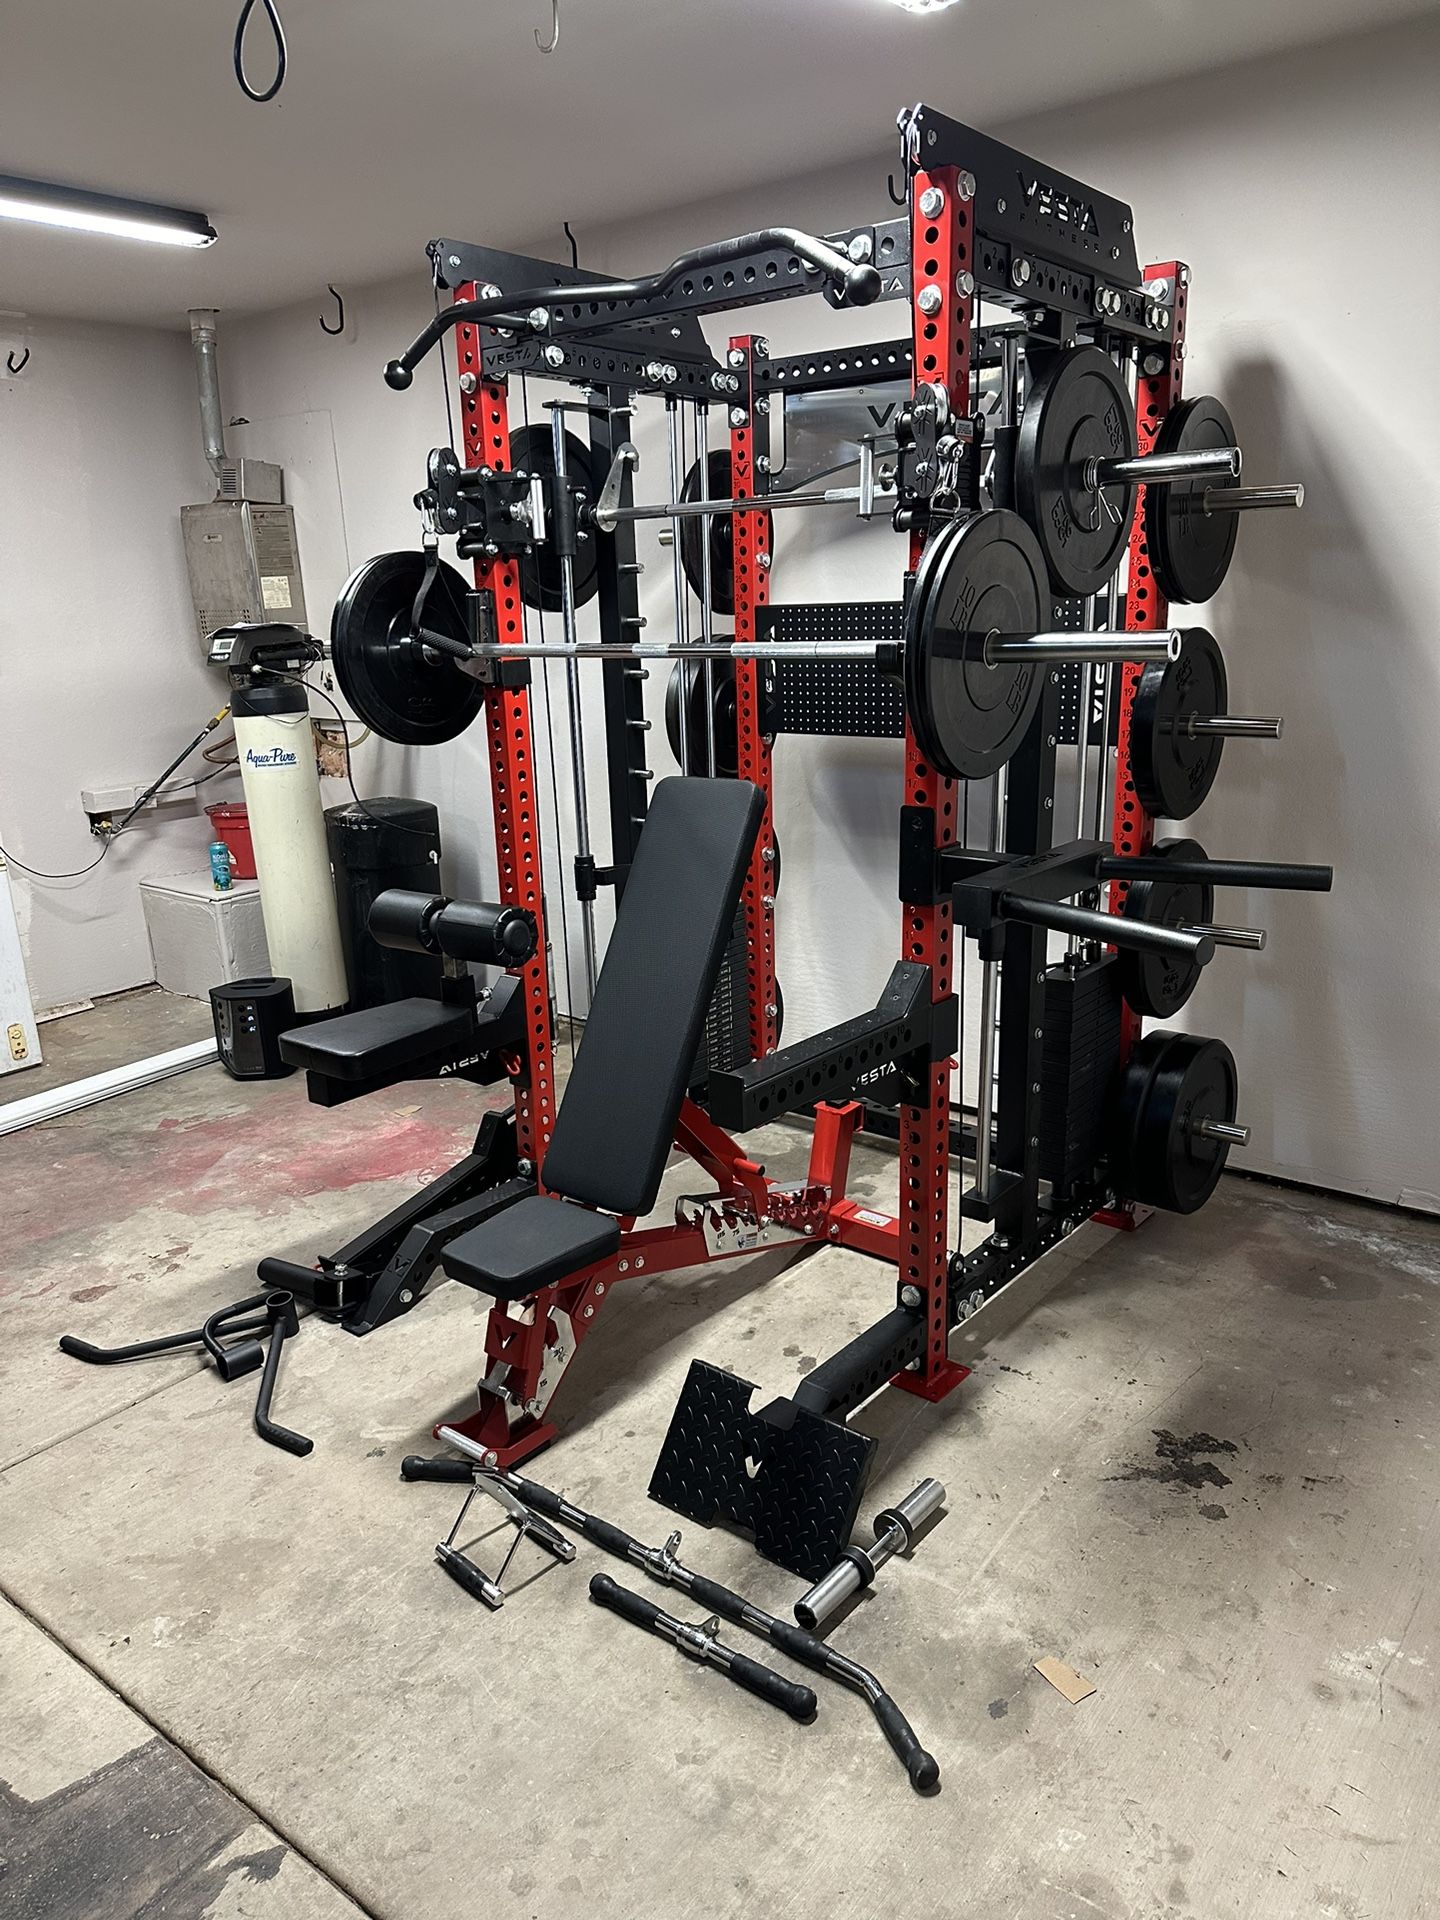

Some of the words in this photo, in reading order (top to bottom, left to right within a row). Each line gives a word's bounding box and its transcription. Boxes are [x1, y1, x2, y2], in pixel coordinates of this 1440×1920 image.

[1016, 169, 1099, 236] VESTA
[992, 247, 998, 260] 2
[833, 277, 904, 301] VTA
[486, 349, 532, 365] VESTA
[1138, 442, 1149, 451] 30
[1133, 511, 1144, 521] 27
[1132, 533, 1145, 544] 26
[1130, 556, 1142, 566] 25
[1129, 601, 1140, 611] 23
[1125, 666, 1136, 676] 20
[1124, 687, 1134, 697] 19
[1122, 708, 1132, 718] 18
[1121, 730, 1131, 739] 17
[246, 747, 297, 768] Aqua-Pure
[1120, 751, 1130, 760] 16
[1119, 772, 1129, 781] 15
[1116, 813, 1126, 822] 13
[1115, 833, 1126, 842] 12
[1112, 891, 1119, 901] 9
[904, 1120, 910, 1130] 3
[903, 1143, 910, 1152] 2
